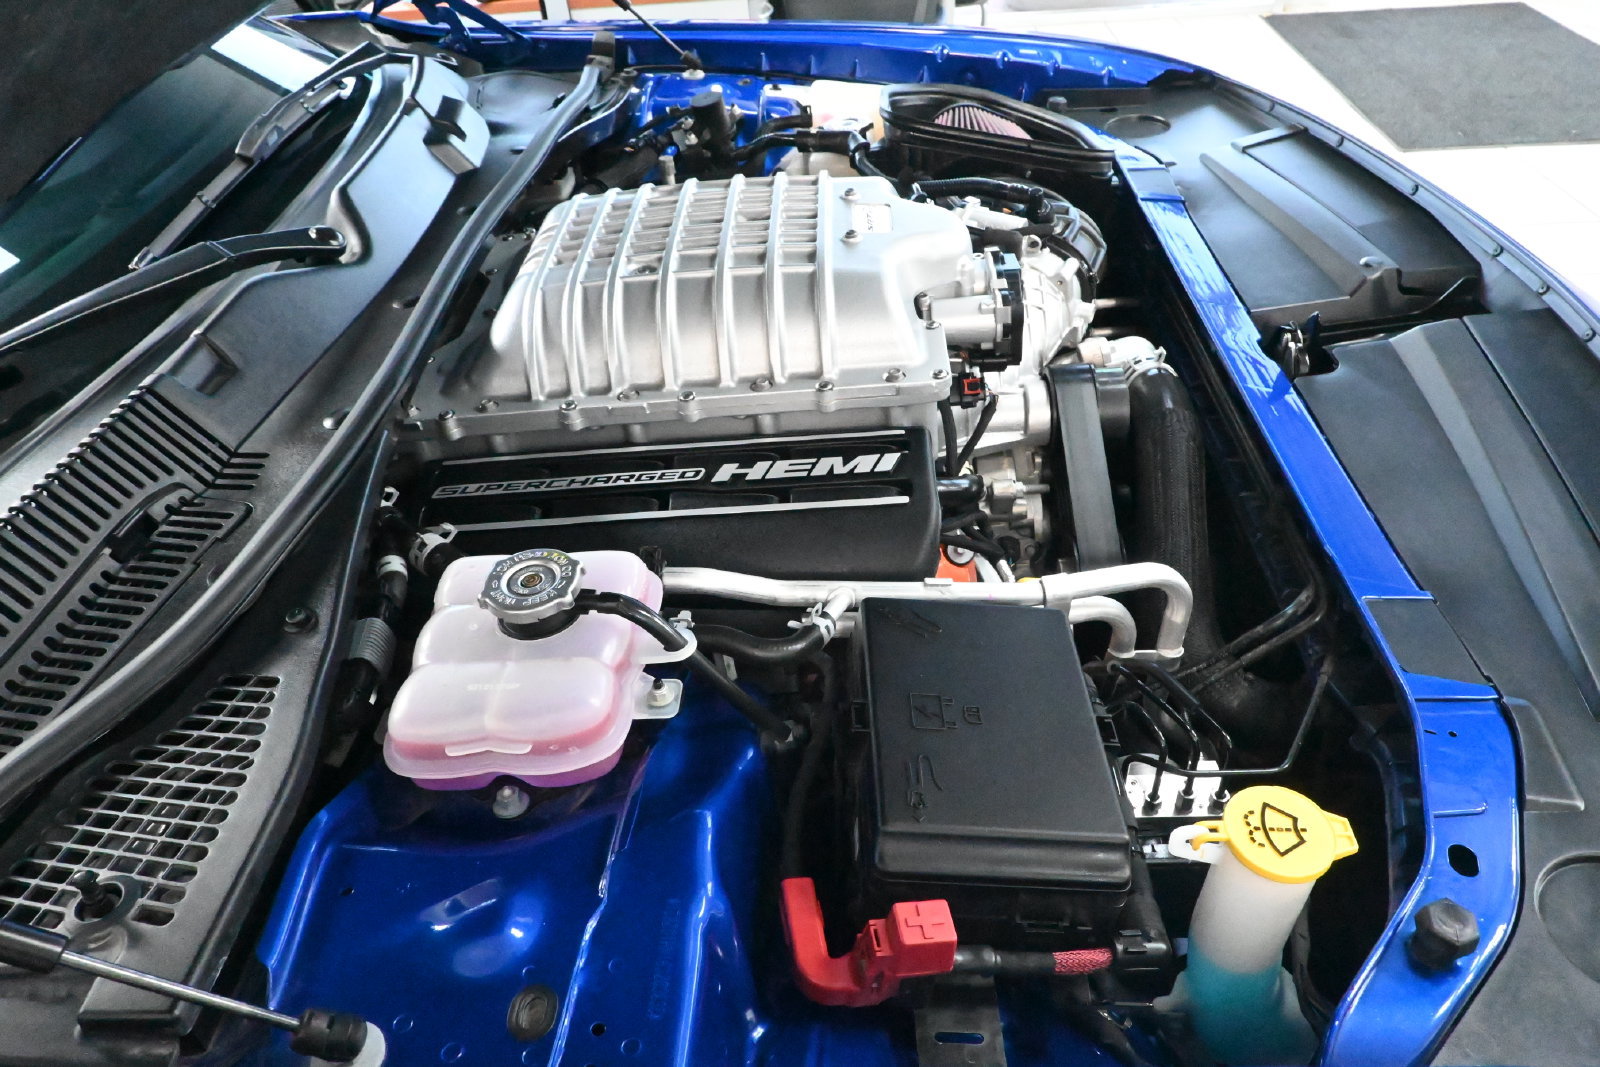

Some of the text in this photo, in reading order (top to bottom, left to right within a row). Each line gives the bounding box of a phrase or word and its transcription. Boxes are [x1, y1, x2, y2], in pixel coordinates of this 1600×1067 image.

[434, 452, 902, 498] SUPERCHARGED HEMI
[523, 589, 557, 605] KEEP
